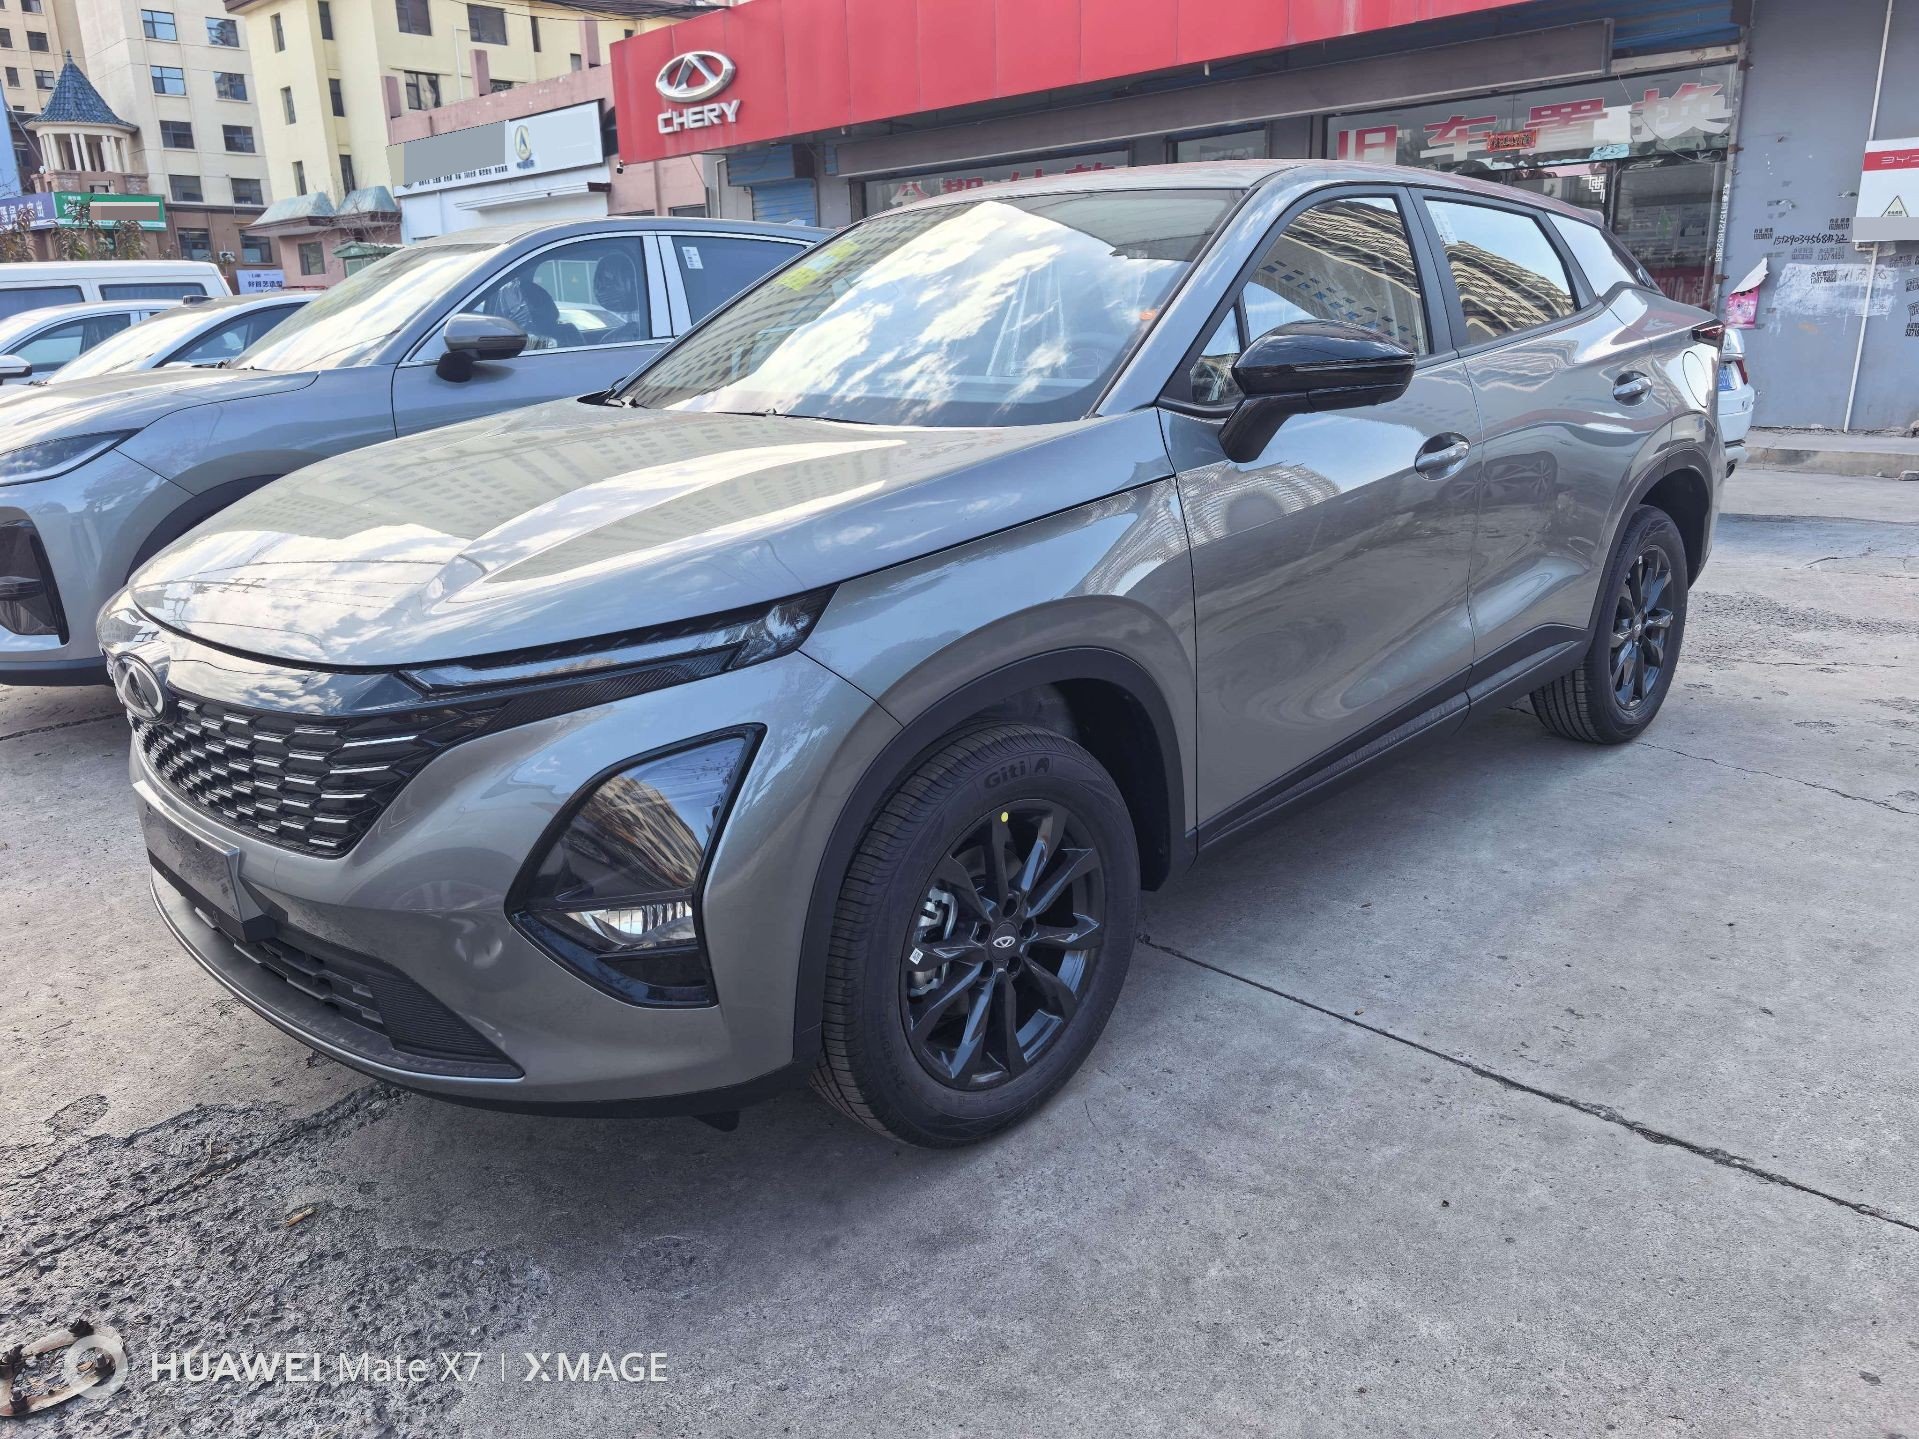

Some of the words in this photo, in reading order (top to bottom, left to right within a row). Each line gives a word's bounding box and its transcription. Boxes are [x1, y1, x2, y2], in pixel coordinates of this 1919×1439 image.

[657, 99, 741, 134] CHERY
[1337, 82, 1733, 164] 旧车置换
